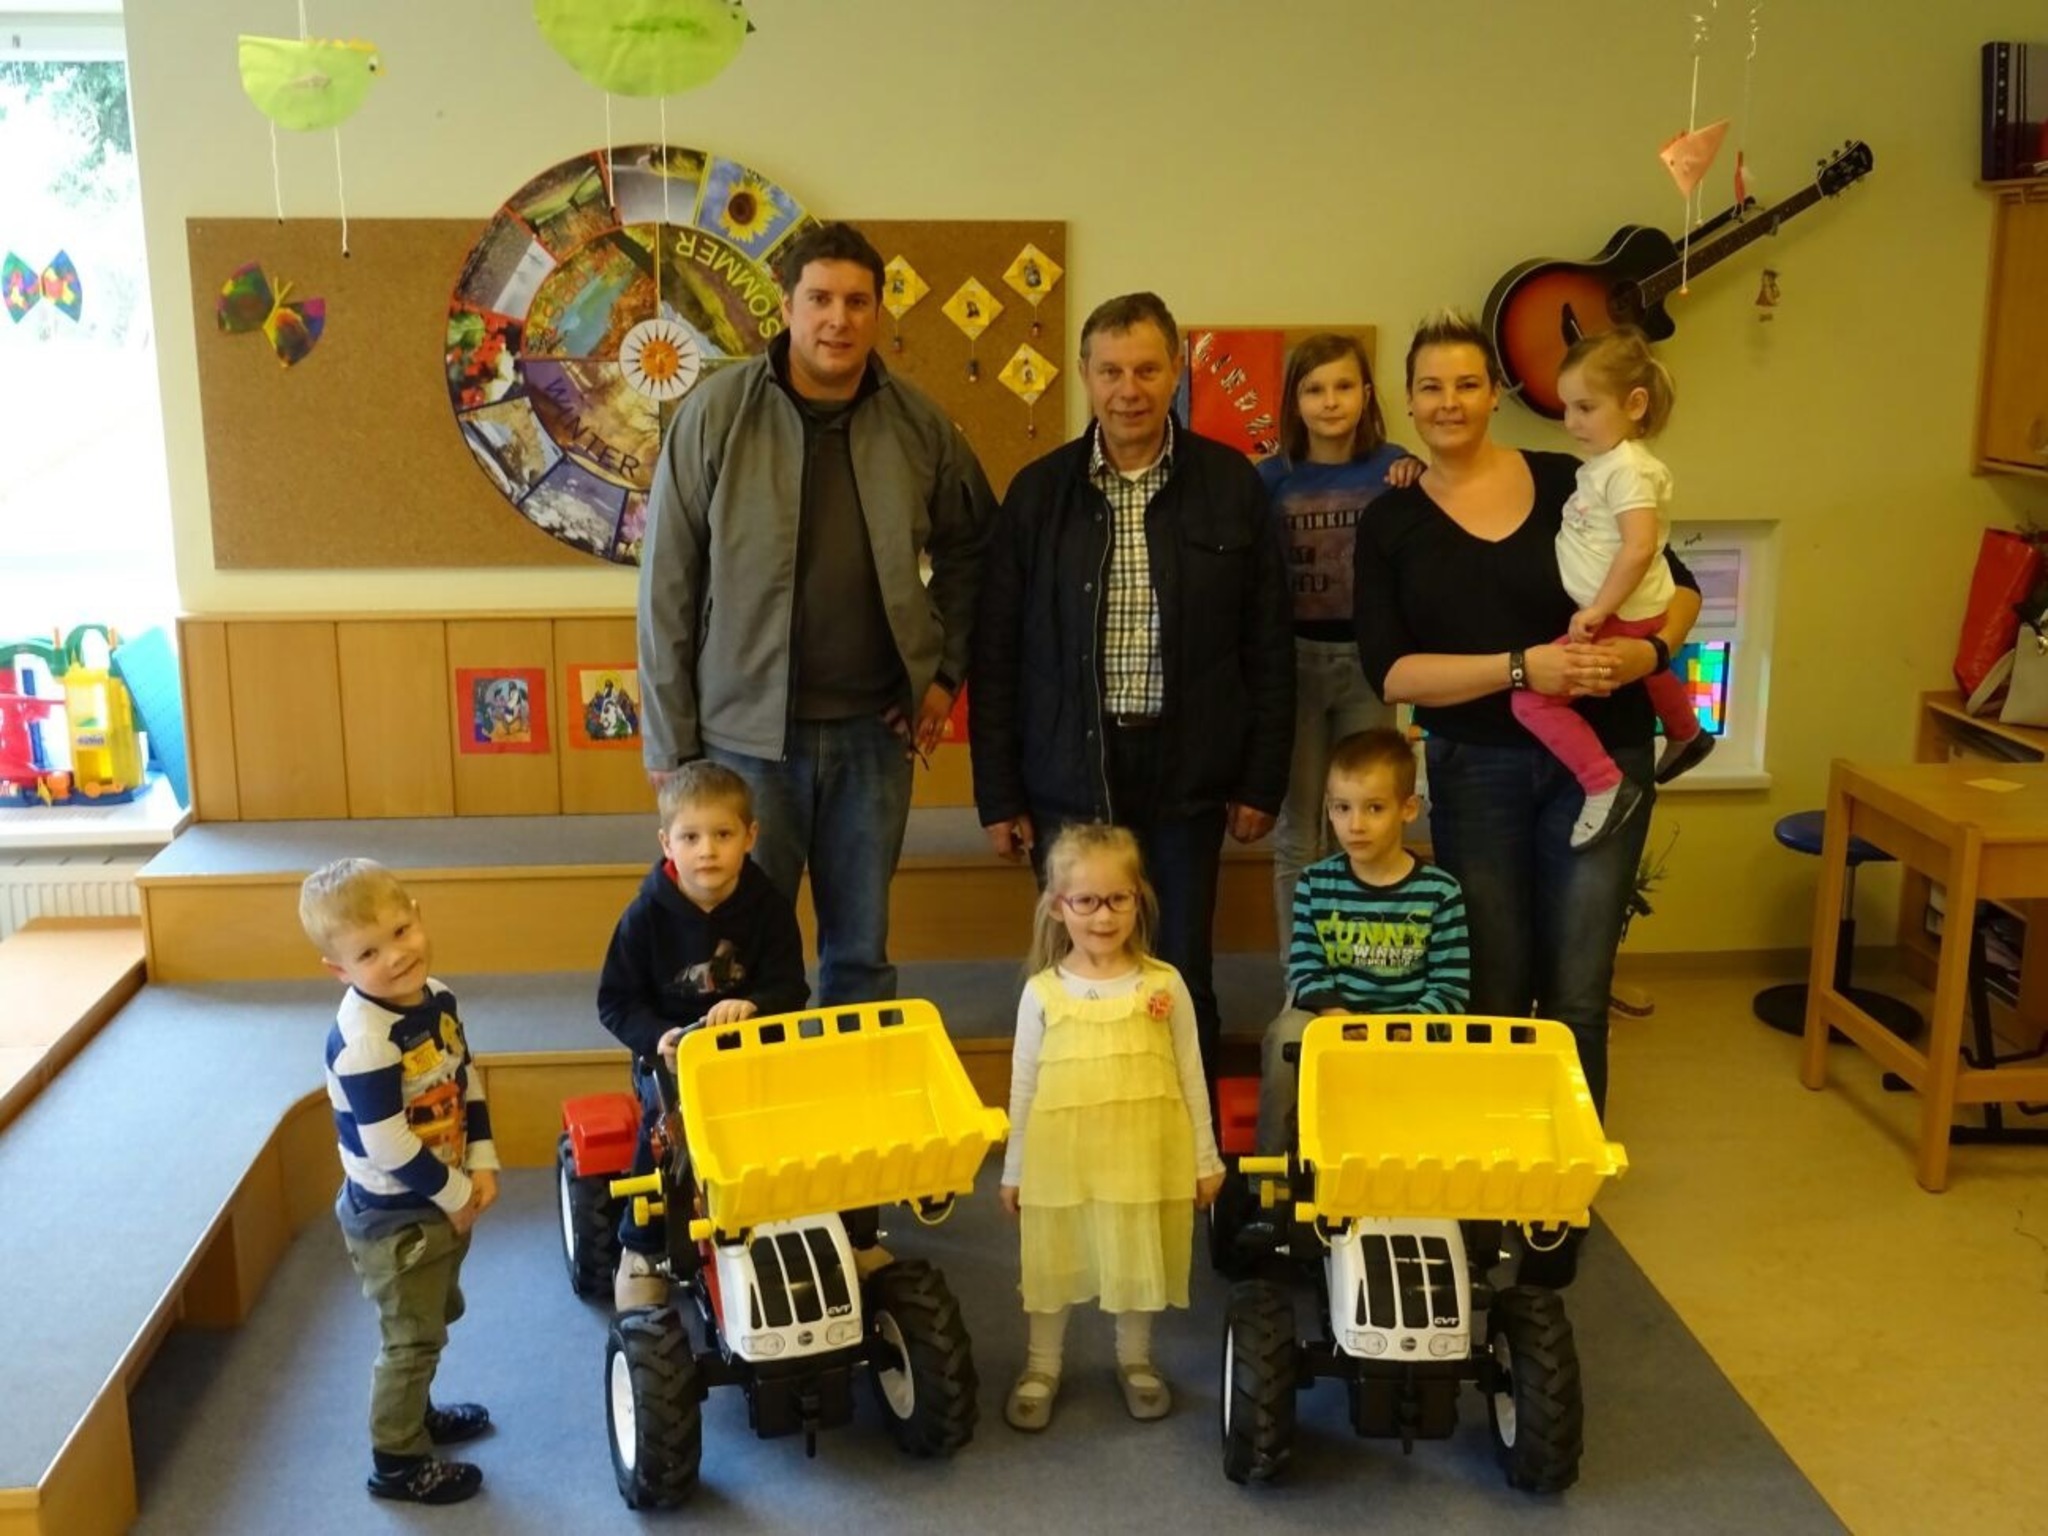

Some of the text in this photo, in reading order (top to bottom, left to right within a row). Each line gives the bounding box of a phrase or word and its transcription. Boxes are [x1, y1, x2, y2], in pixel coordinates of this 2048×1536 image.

[676, 231, 781, 339] SOMMER
[545, 377, 640, 478] WINTER
[1314, 911, 1432, 948] FUNNY
[1434, 1317, 1459, 1325] CVT
